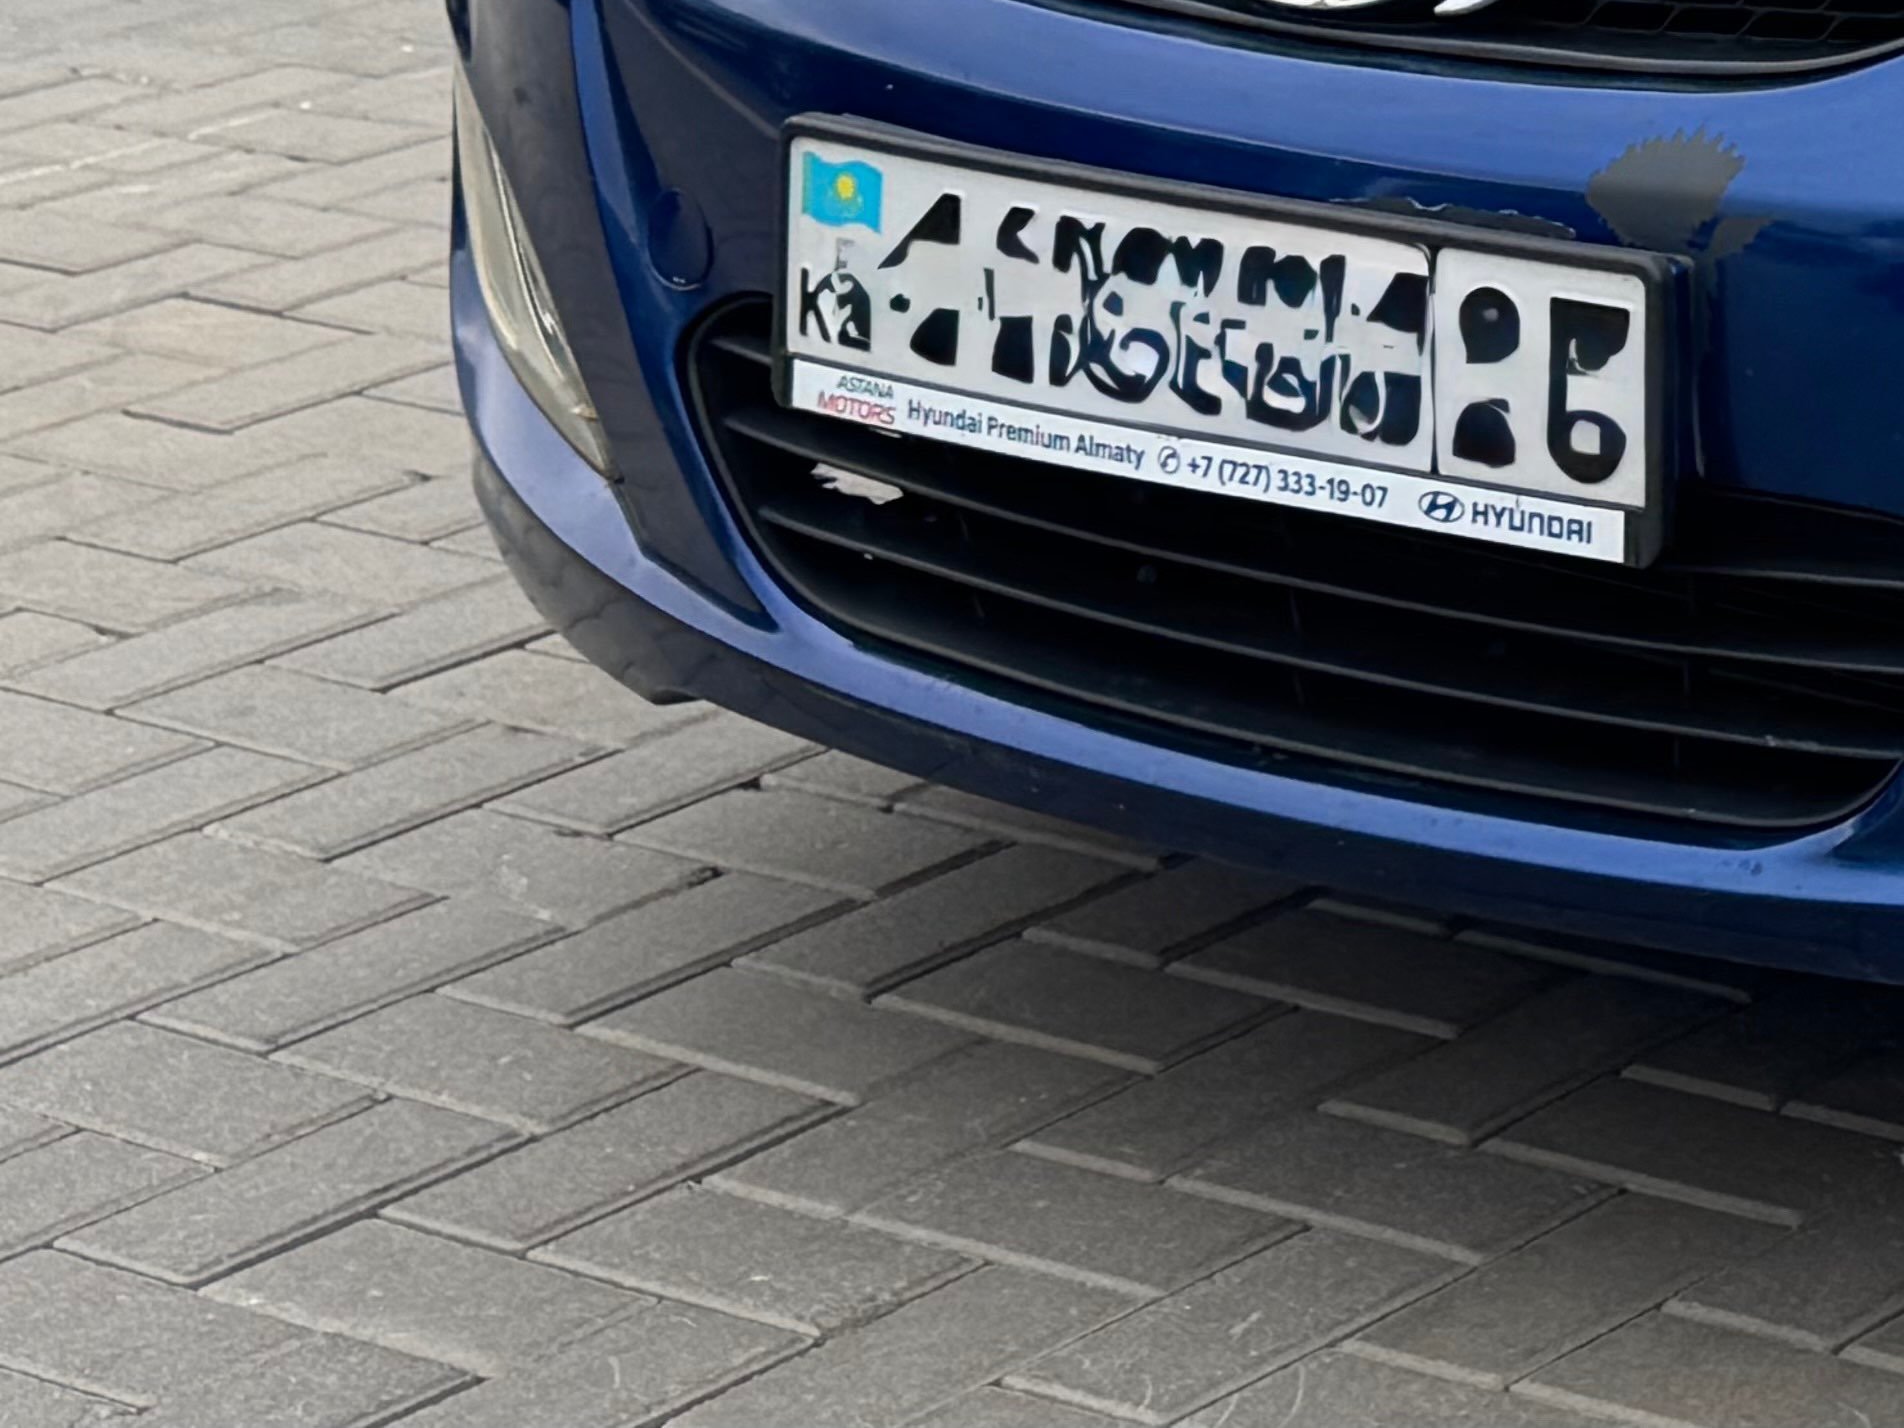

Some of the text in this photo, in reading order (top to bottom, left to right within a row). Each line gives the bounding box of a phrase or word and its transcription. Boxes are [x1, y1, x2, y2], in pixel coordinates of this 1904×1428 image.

[837, 374, 894, 399] ASTANA
[817, 390, 896, 425] MOTORS
[907, 399, 1389, 509] Hyundai Premium Almaty +7 (727) 333-19-07
[1470, 500, 1593, 545] HYUNDAI
